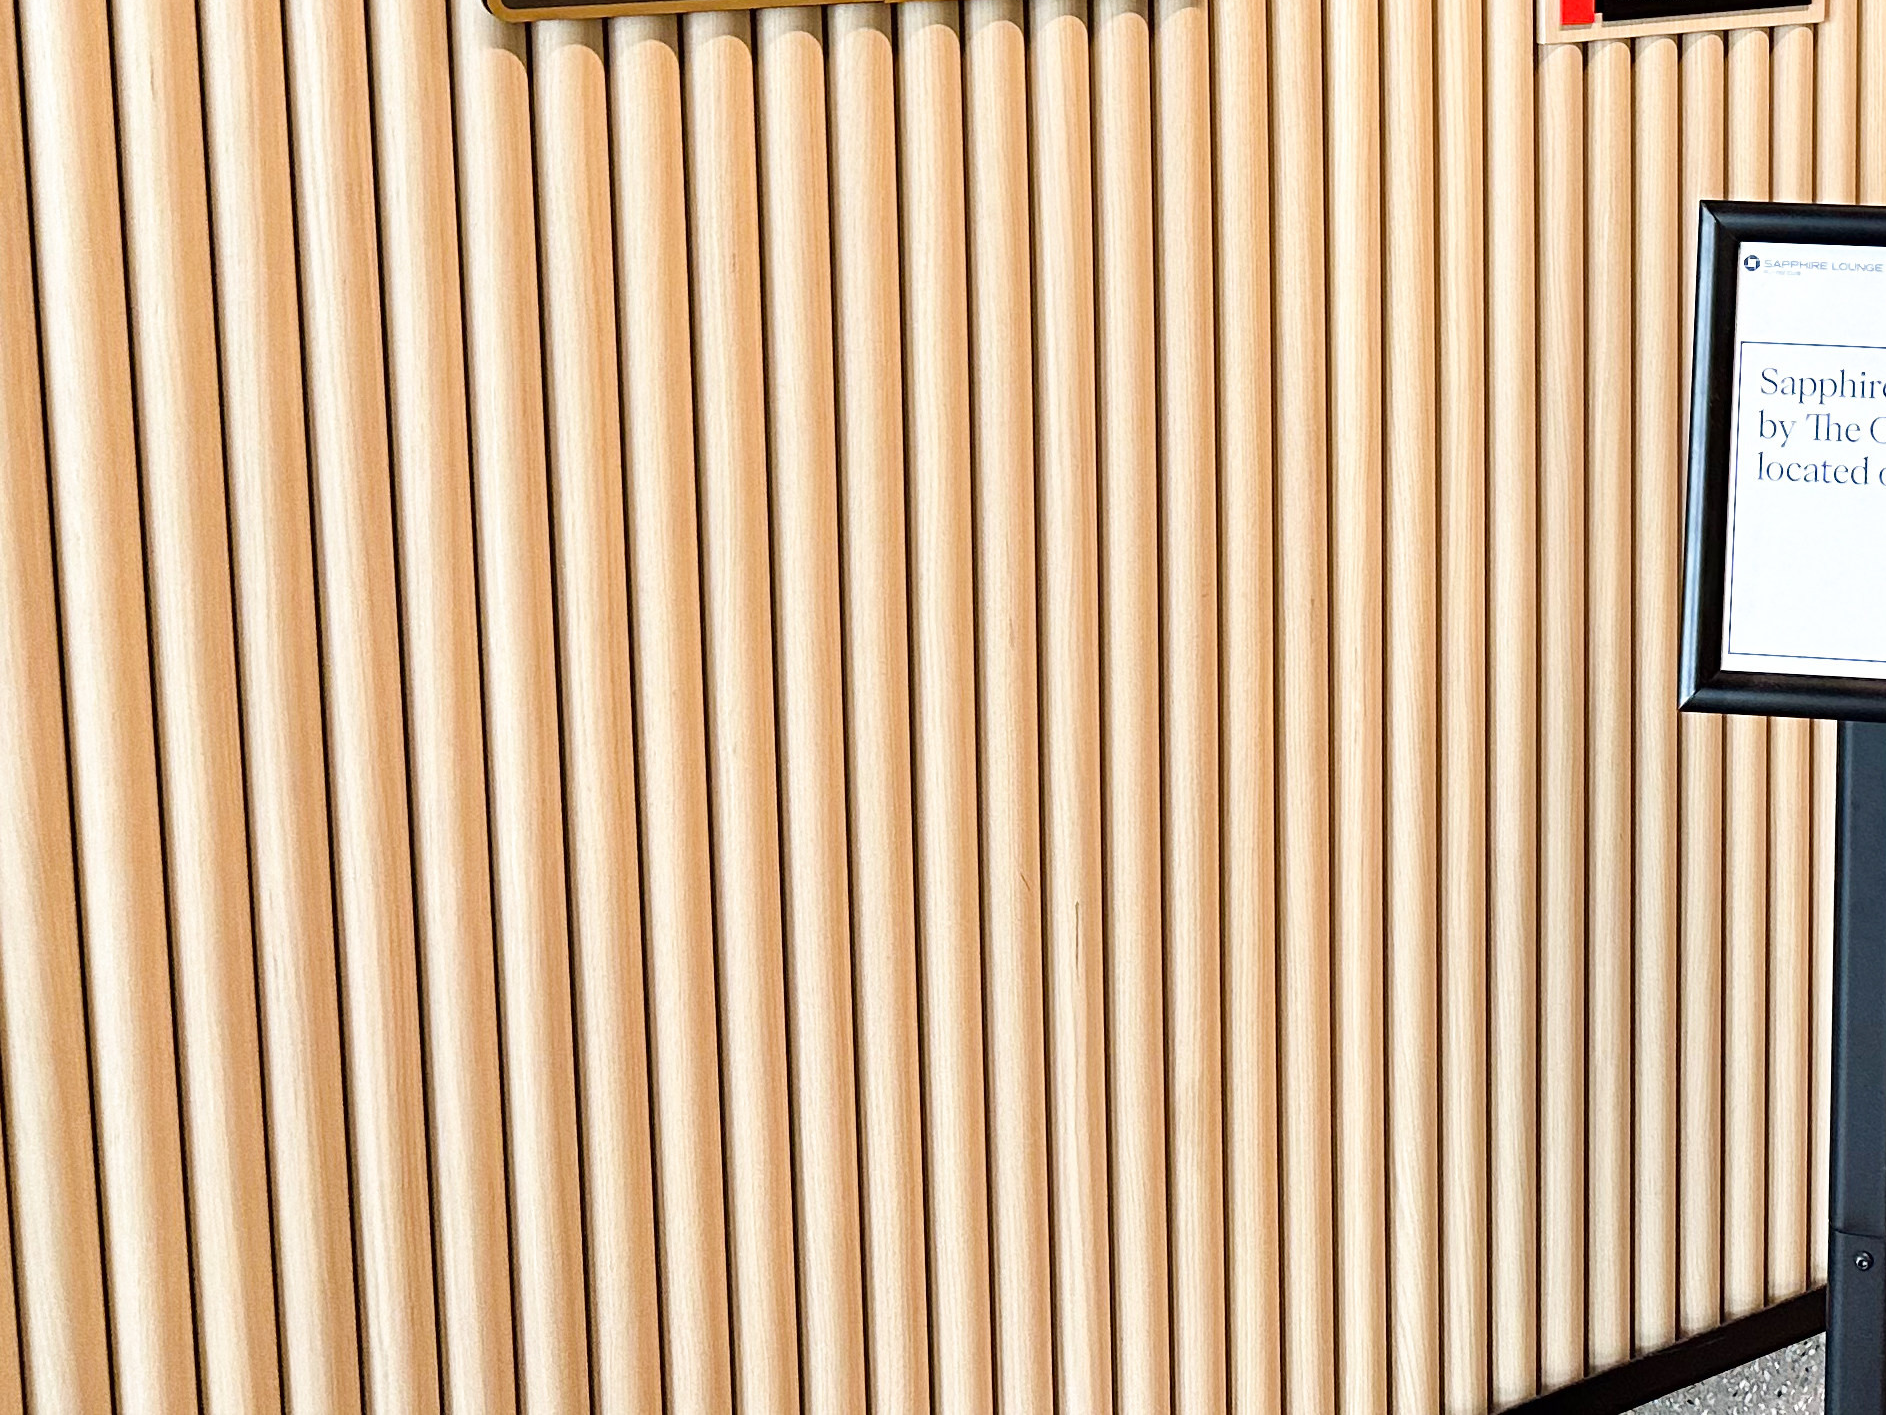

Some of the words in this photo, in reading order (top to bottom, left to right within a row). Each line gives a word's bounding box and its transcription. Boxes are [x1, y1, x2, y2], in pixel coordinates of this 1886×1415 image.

[1764, 259, 1828, 271] SAPPHIRE
[1832, 262, 1884, 273] LOUNGE
[1758, 409, 1797, 448] by
[1805, 412, 1861, 443] The
[1757, 451, 1869, 486] located
